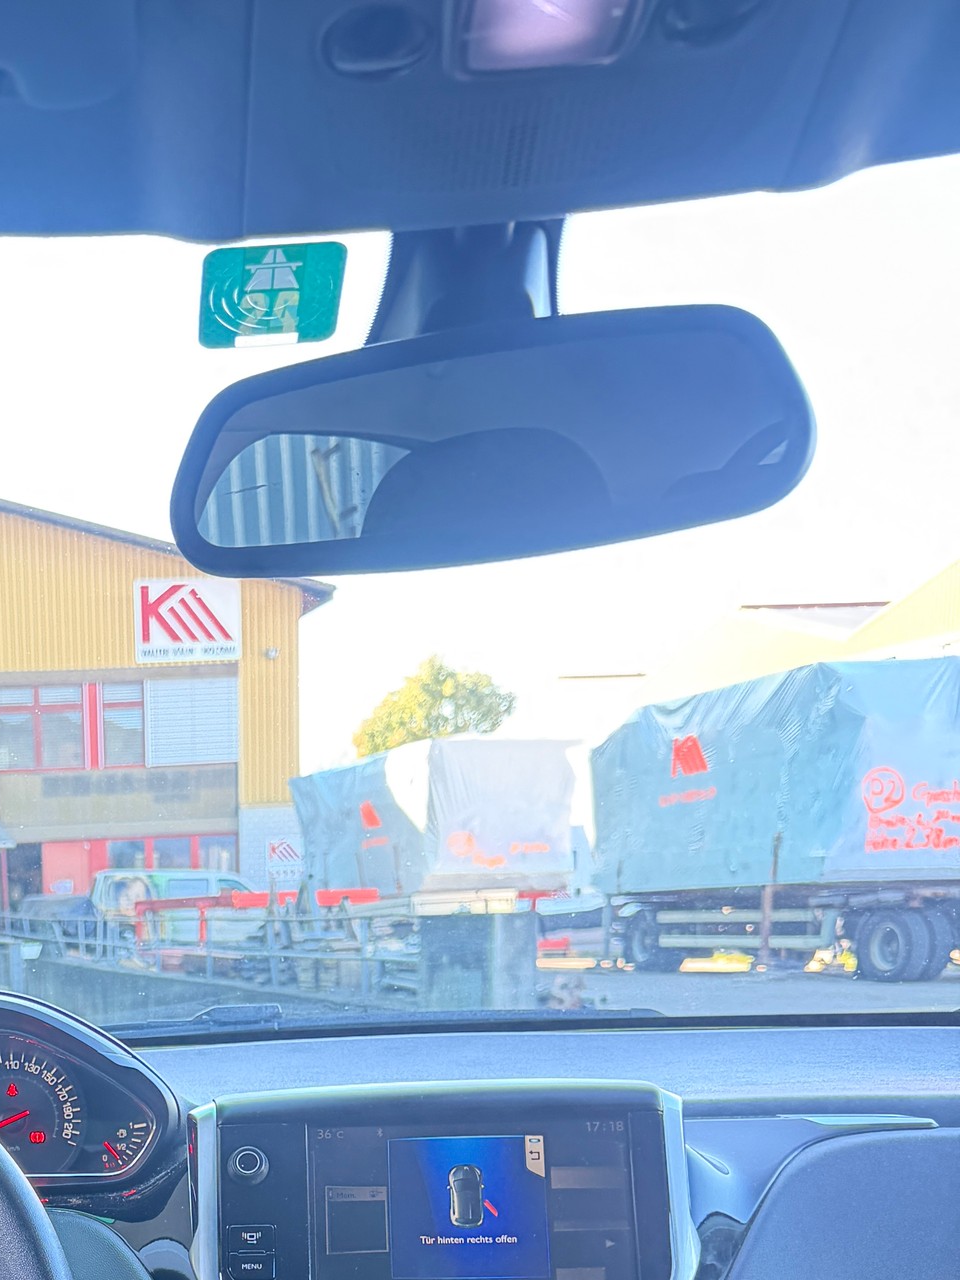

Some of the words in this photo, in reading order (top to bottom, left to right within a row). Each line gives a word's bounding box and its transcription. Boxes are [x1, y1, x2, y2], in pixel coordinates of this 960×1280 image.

[4, 1060, 20, 1070] 110
[24, 1062, 41, 1075] 130
[41, 1070, 57, 1086] 150
[54, 1084, 68, 1102] 170
[62, 1102, 74, 1120] 190
[62, 1122, 73, 1140] 210
[586, 1121, 624, 1132] 17:18
[420, 1235, 435, 1245] Tür
[437, 1235, 465, 1244] hinten
[467, 1235, 493, 1244] rechts
[495, 1234, 518, 1244] offen
